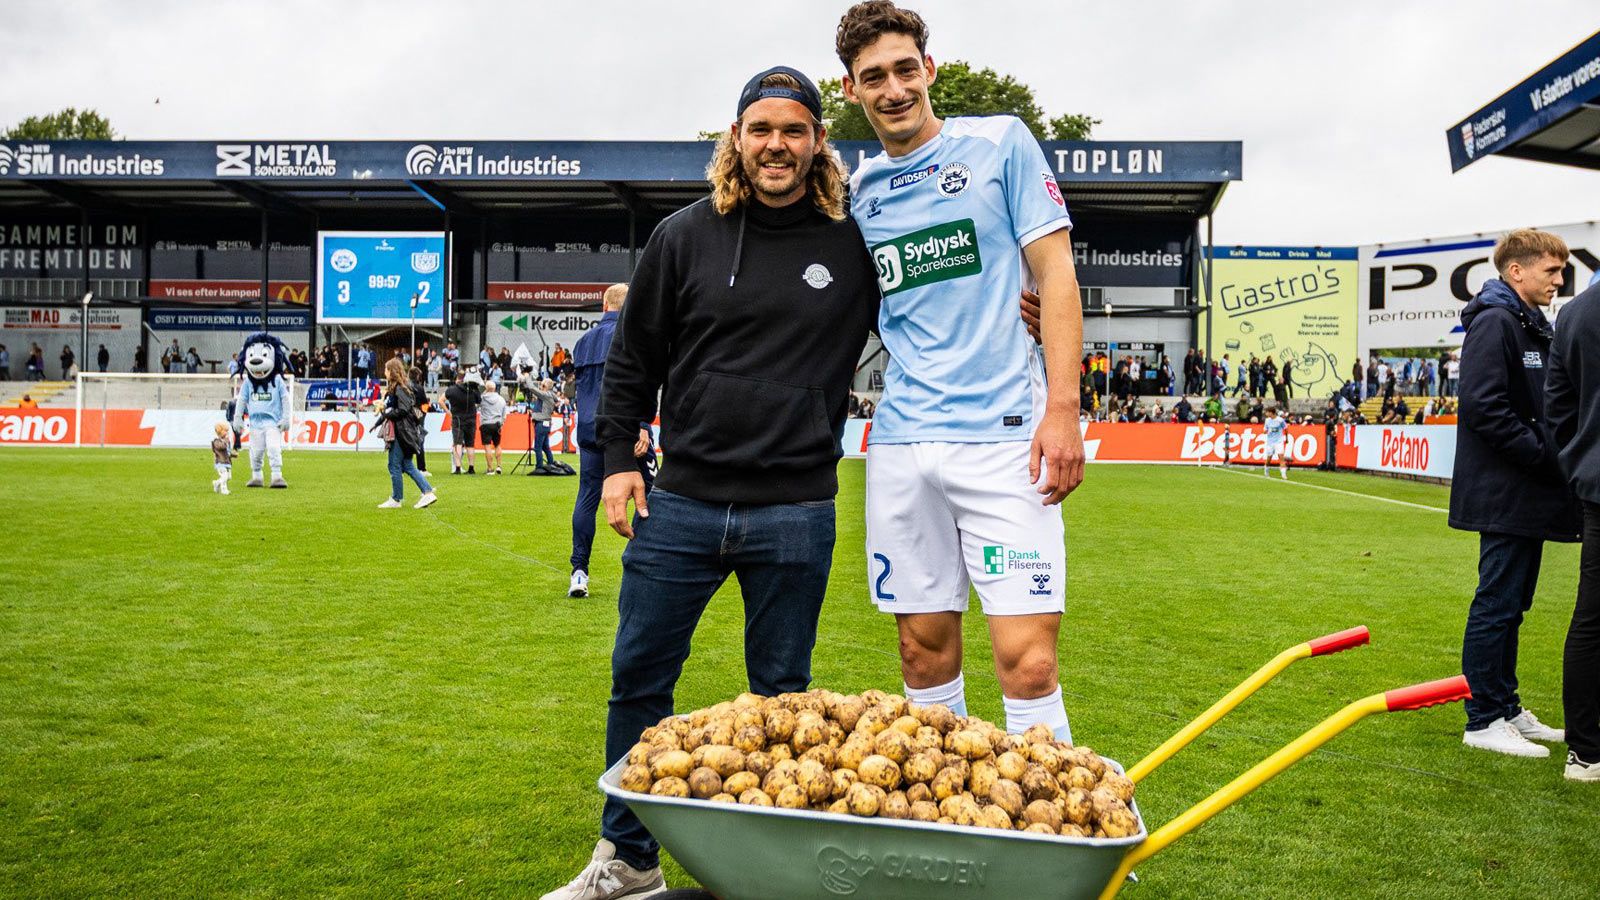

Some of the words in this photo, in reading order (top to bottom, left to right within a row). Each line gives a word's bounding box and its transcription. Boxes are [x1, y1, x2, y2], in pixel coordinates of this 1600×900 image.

[1475, 125, 1507, 151] Kommune
[254, 144, 336, 165] METAL
[457, 147, 473, 155] NEW
[59, 154, 164, 176] Industries
[254, 166, 336, 177] SØNDERJYLLAND
[478, 154, 581, 176] Industries
[1055, 149, 1163, 174] TOPLØN
[893, 168, 929, 188] DAVIDSEN
[106, 225, 137, 245] OM
[904, 229, 972, 262] Sydjysk
[1229, 249, 1248, 257] Kaffe
[1257, 250, 1281, 258] Snacks
[1288, 250, 1310, 258] Drinks
[1316, 250, 1332, 258] Mad
[0, 248, 132, 269] FREMTIDEN
[906, 252, 975, 278] Sparekasse
[1092, 249, 1183, 267] Industries
[337, 280, 351, 304] 3
[368, 275, 401, 289] 99:57
[1219, 264, 1341, 312] Gastro's
[165, 287, 175, 297] Vi
[178, 289, 194, 298] ses
[196, 287, 218, 298] efter
[219, 287, 261, 299] kampen!
[418, 281, 431, 304] 2
[504, 290, 514, 300] Vi
[516, 292, 532, 301] ses
[534, 290, 558, 301] efter
[559, 289, 603, 302] kampen!
[31, 309, 60, 323] MAD
[154, 315, 176, 325] ØSBY
[177, 315, 235, 325] ENTREPRENØR
[237, 316, 243, 324] &
[244, 315, 306, 326] KLOSERVICE
[1381, 428, 1429, 471] Betano
[1008, 550, 1040, 560] Dansk
[1008, 560, 1052, 570] Fliserens
[873, 552, 896, 601] 2
[1029, 588, 1052, 596] hummel
[882, 852, 988, 887] GARDEN
